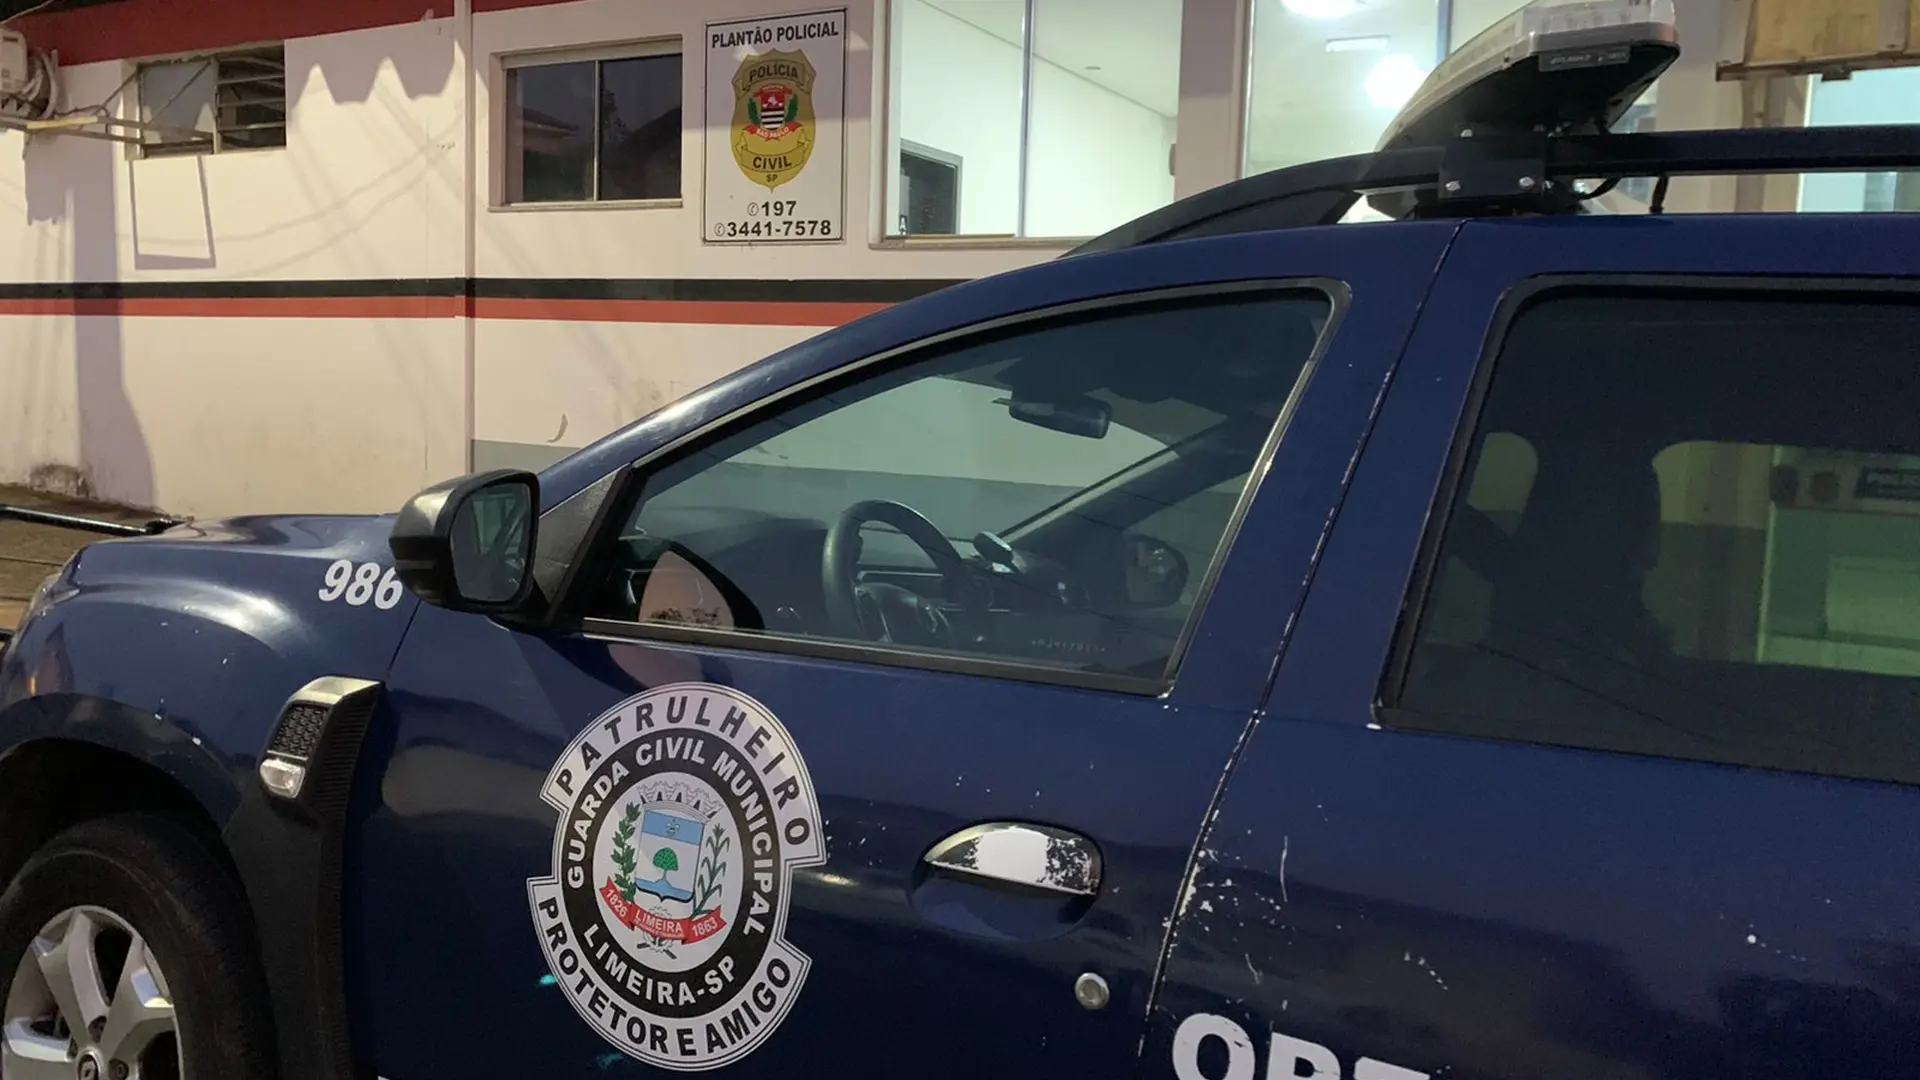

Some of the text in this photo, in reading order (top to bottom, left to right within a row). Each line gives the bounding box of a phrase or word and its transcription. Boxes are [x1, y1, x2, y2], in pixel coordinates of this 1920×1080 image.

[712, 21, 839, 48] PLANTÃO POLICIAL
[752, 156, 792, 170] CIVIL
[766, 174, 777, 182] SP
[727, 220, 831, 237] 3441-7578
[761, 201, 797, 216] 197
[318, 560, 403, 610] 986
[556, 696, 810, 846] PATRULHEIRO
[567, 736, 774, 937] GUARDA CIVIL MUNICIPAL
[606, 889, 628, 918] 1826
[635, 910, 684, 934] LIMEIRA
[691, 917, 718, 937] 1863
[538, 896, 790, 1056] PROTETOR E AMIGO
[583, 924, 736, 1006] LIMEIRA-SP
